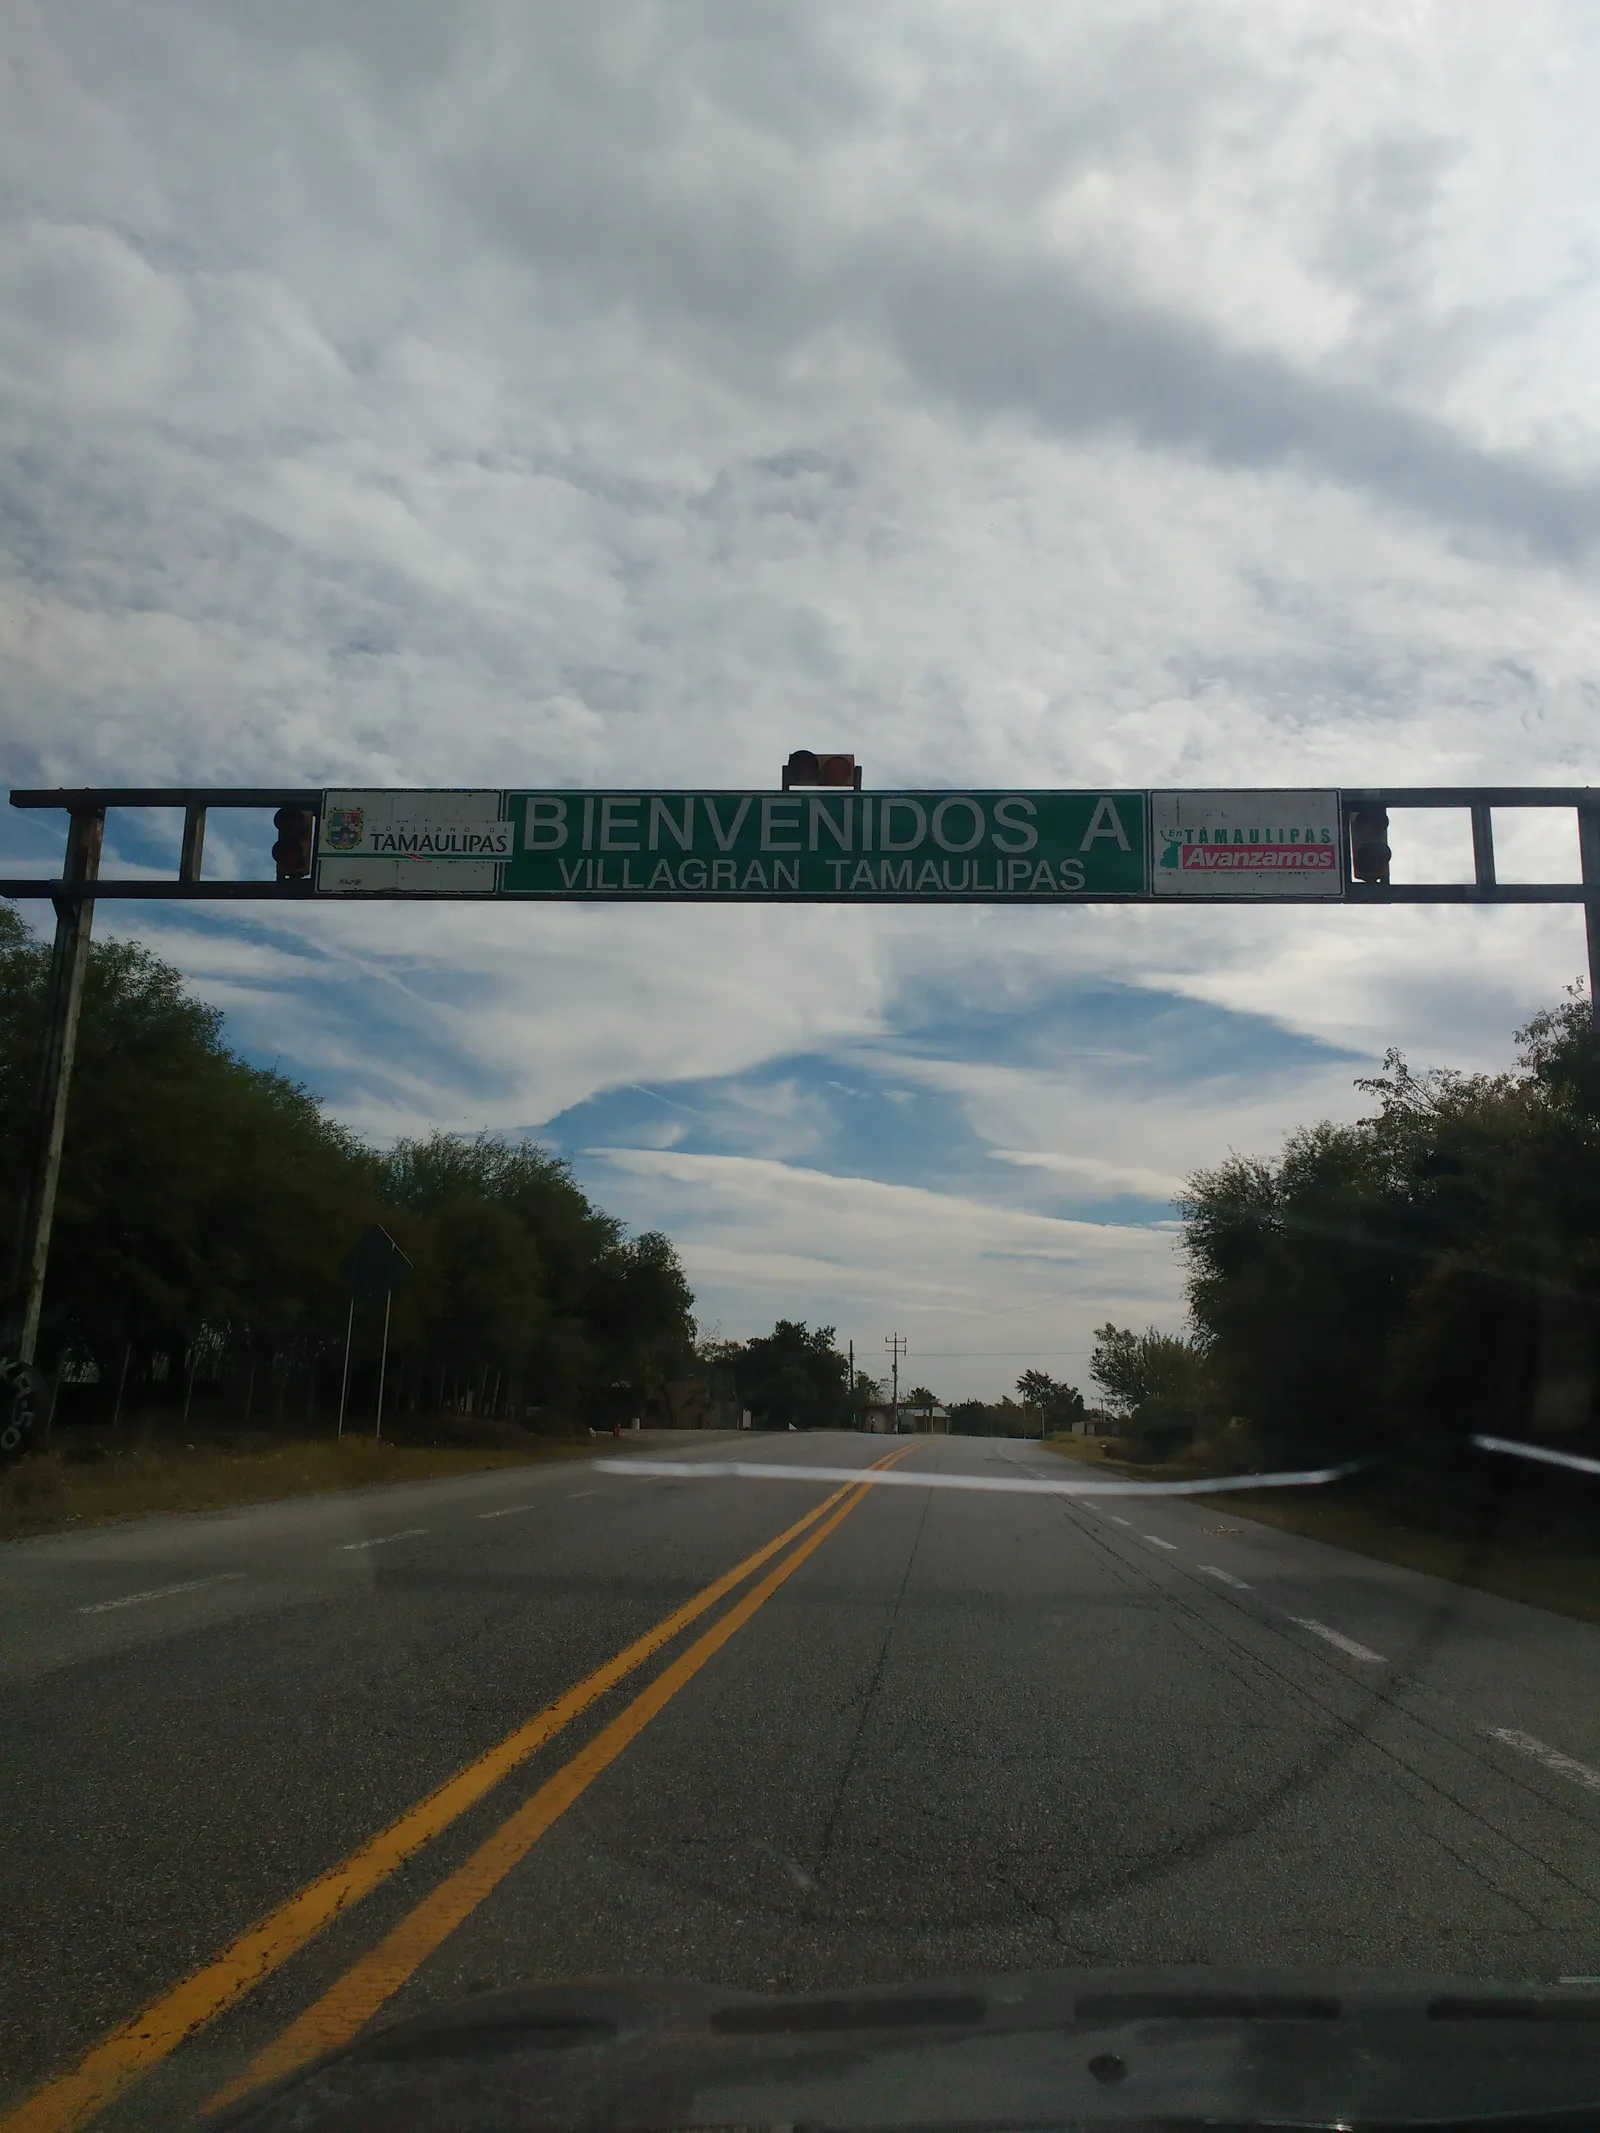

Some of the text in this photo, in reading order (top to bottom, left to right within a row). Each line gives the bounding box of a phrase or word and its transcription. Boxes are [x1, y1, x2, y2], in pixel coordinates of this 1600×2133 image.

[523, 797, 1131, 854] BIENVENIDOS A
[370, 833, 507, 853] TAMAULIPAS
[1168, 829, 1332, 844] En TAMAULIPAS
[1185, 847, 1332, 867] Avanzamos
[558, 859, 1086, 891] VILLAGRAN TAMAULIPAS
